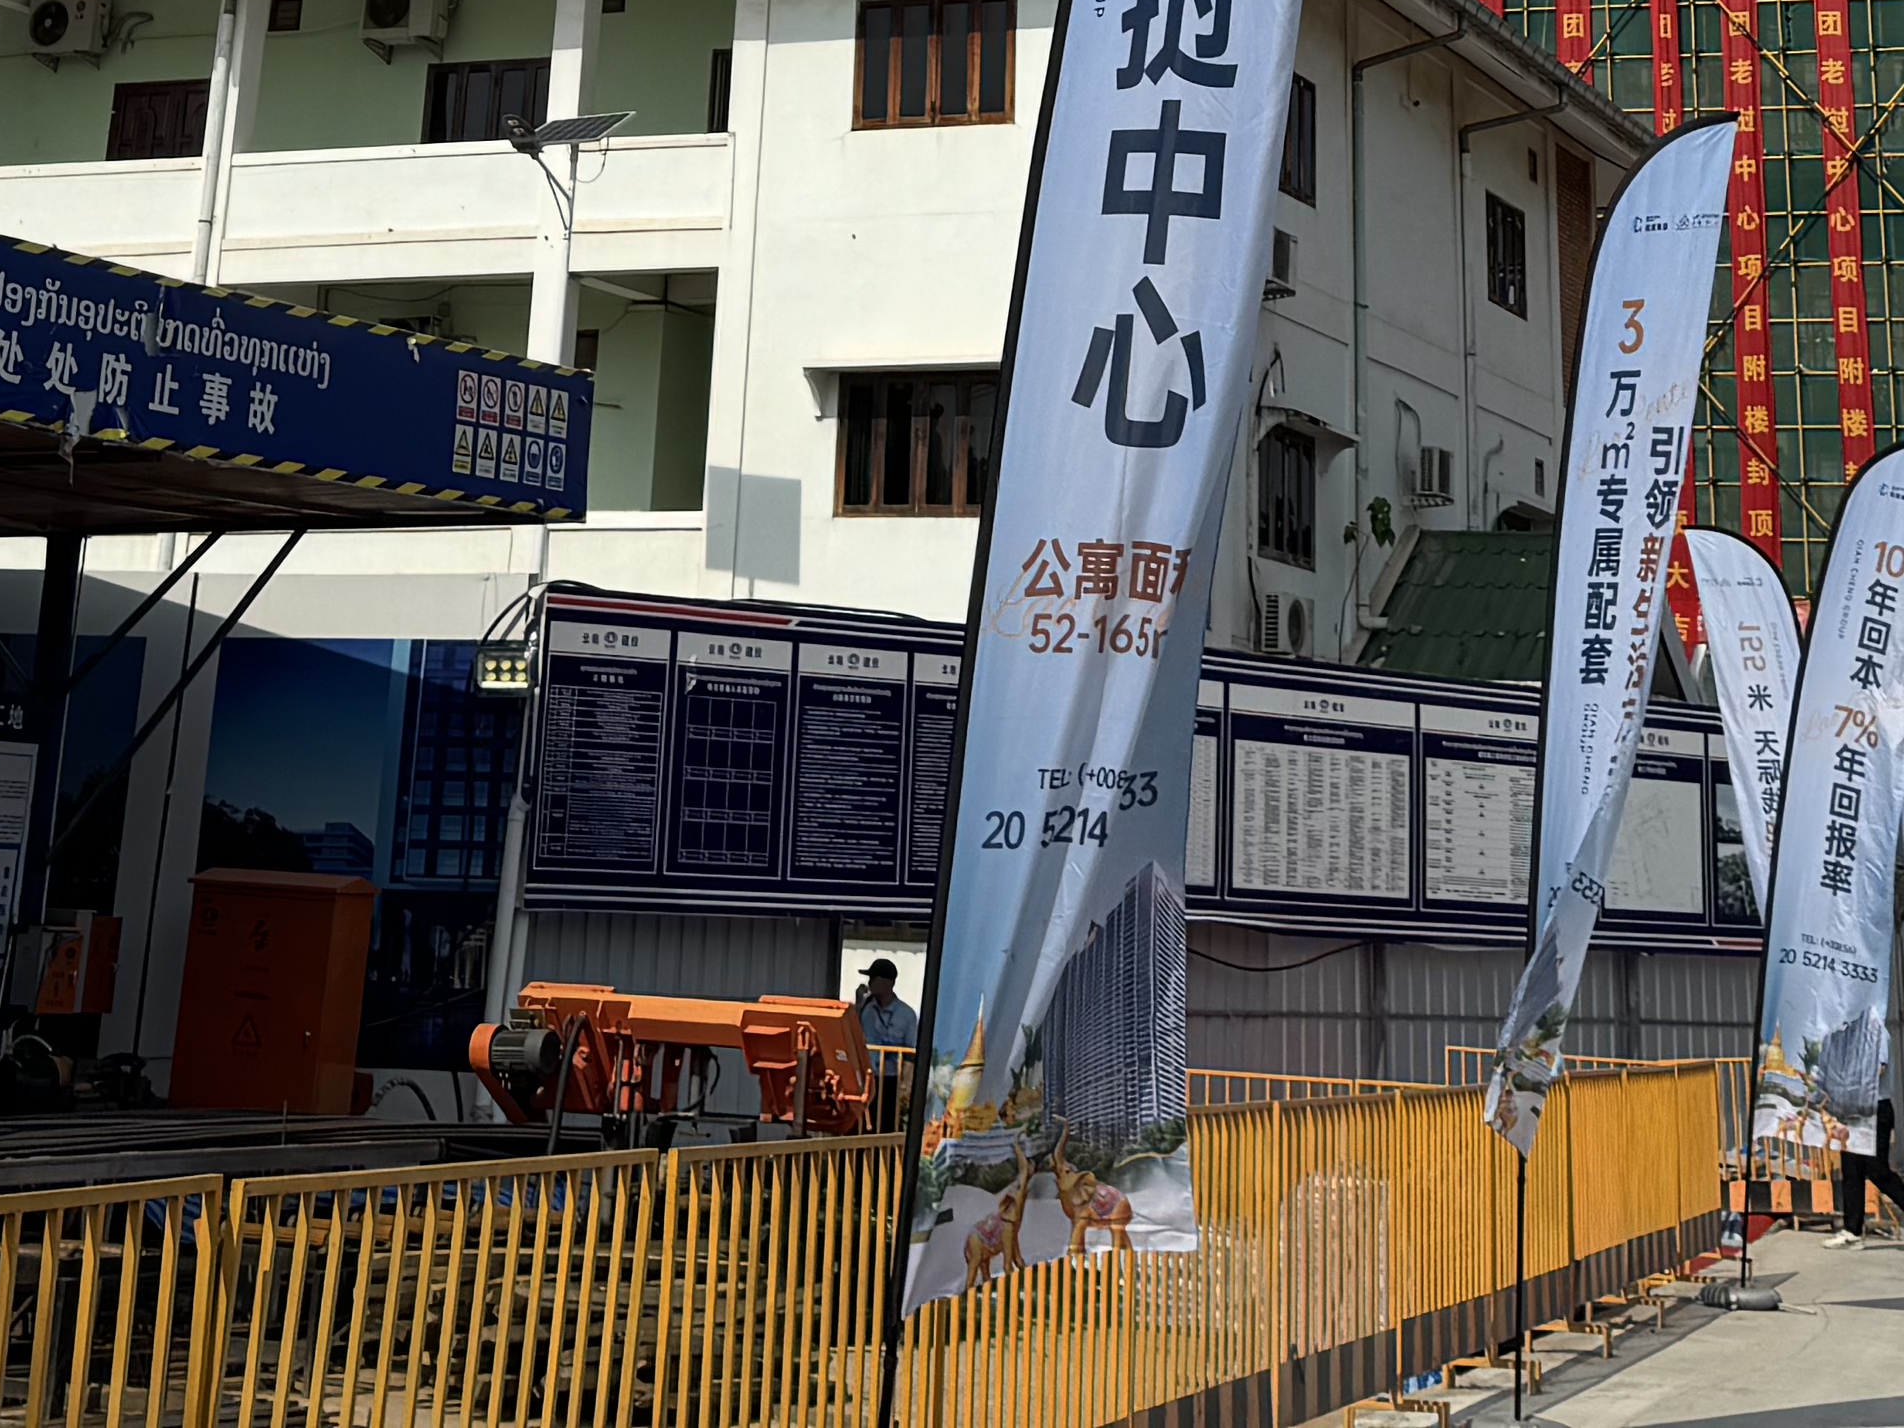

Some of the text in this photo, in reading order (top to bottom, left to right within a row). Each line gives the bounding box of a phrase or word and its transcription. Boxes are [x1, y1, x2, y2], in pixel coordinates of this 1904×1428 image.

[1820, 704, 1880, 897] 7%年回报率
[983, 811, 1025, 851] 20
[1779, 948, 1878, 985] 20 5214 3333
